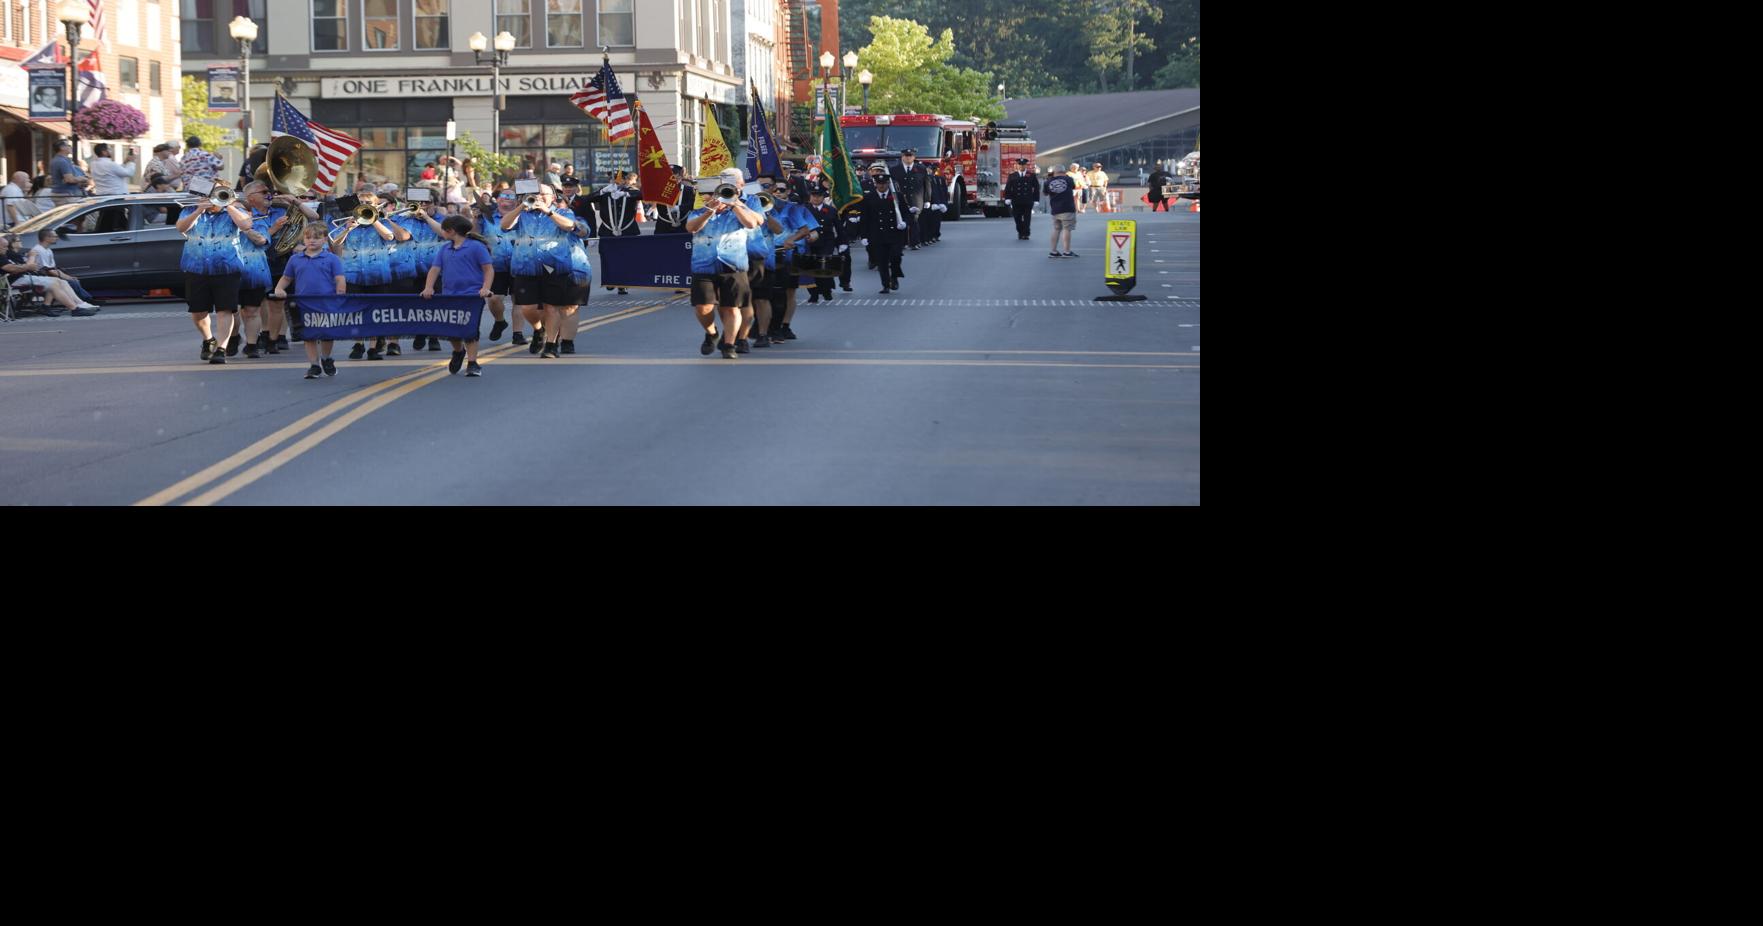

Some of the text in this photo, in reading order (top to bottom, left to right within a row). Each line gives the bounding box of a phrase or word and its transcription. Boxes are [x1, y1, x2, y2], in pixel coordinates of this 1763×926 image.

[343, 77, 593, 94] ONE FRANKLIN SQUAR
[661, 181, 676, 198] FIRE
[654, 274, 680, 285] FIRE
[303, 309, 472, 328] SAVANNAH CELLARSAVERS
